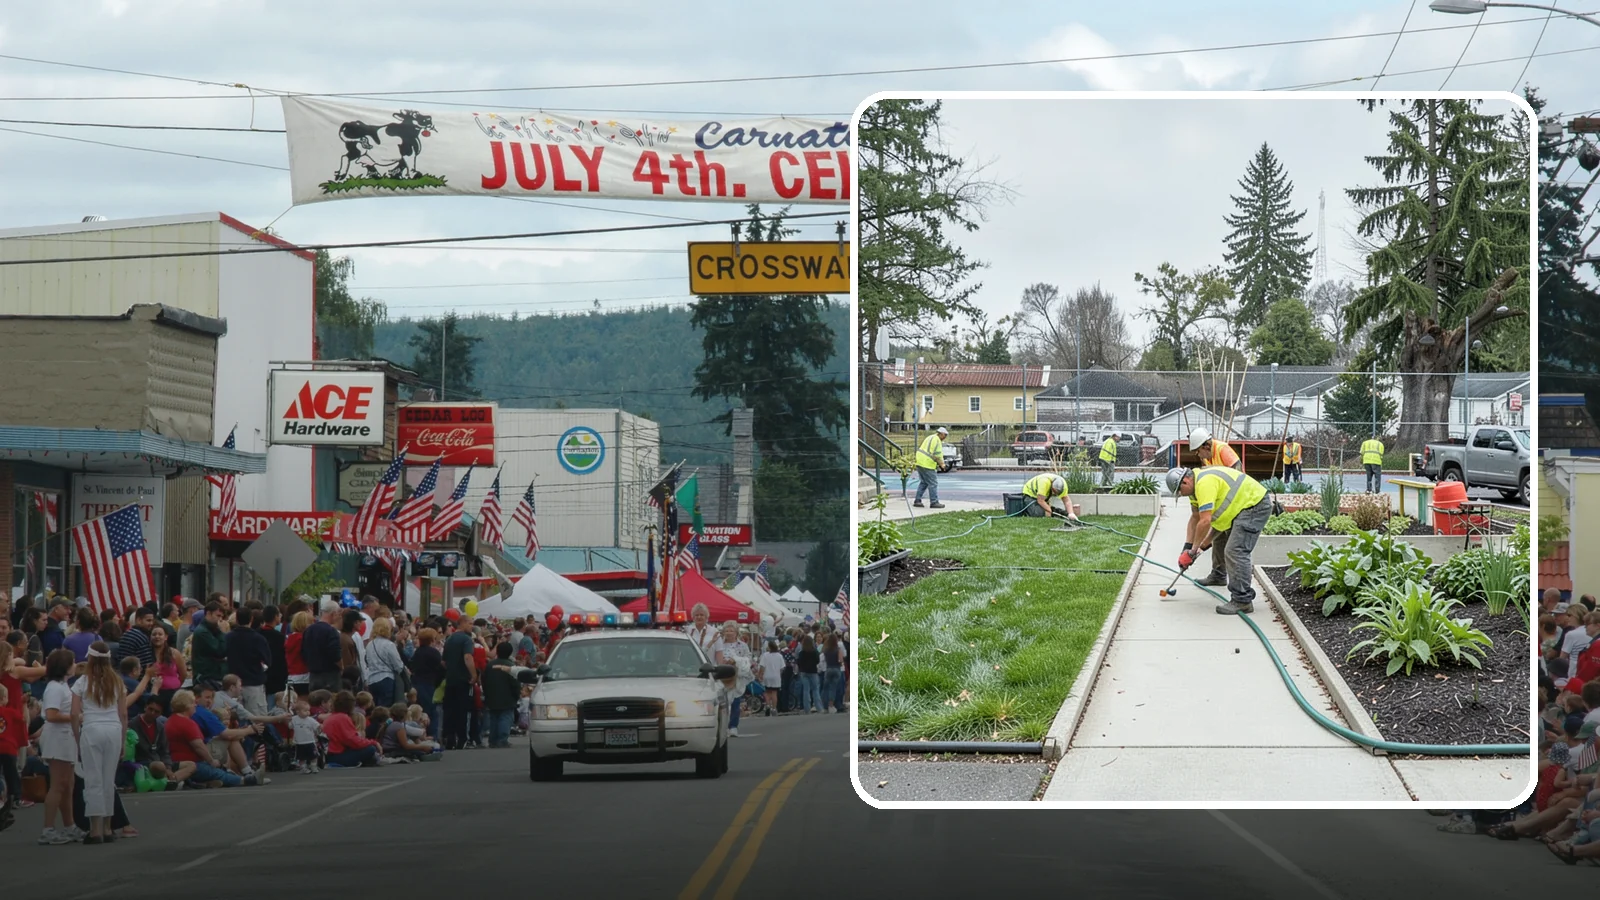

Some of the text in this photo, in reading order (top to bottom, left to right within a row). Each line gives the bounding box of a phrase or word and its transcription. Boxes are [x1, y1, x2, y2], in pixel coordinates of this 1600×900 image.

[481, 141, 604, 192] JULY
[632, 150, 747, 198] 4th.
[697, 254, 850, 280] CROSSWA
[282, 380, 374, 420] ACE
[405, 409, 452, 421] CEDAR
[283, 421, 370, 437] Hardware
[416, 428, 477, 447] Coca-Cola
[353, 467, 385, 481] Simpl
[96, 485, 124, 495] Vincent
[126, 486, 135, 495] de
[137, 486, 155, 495] Paul
[213, 516, 330, 535] HARDARE
[688, 526, 741, 535] CRNATION
[699, 535, 730, 543] GLASS
